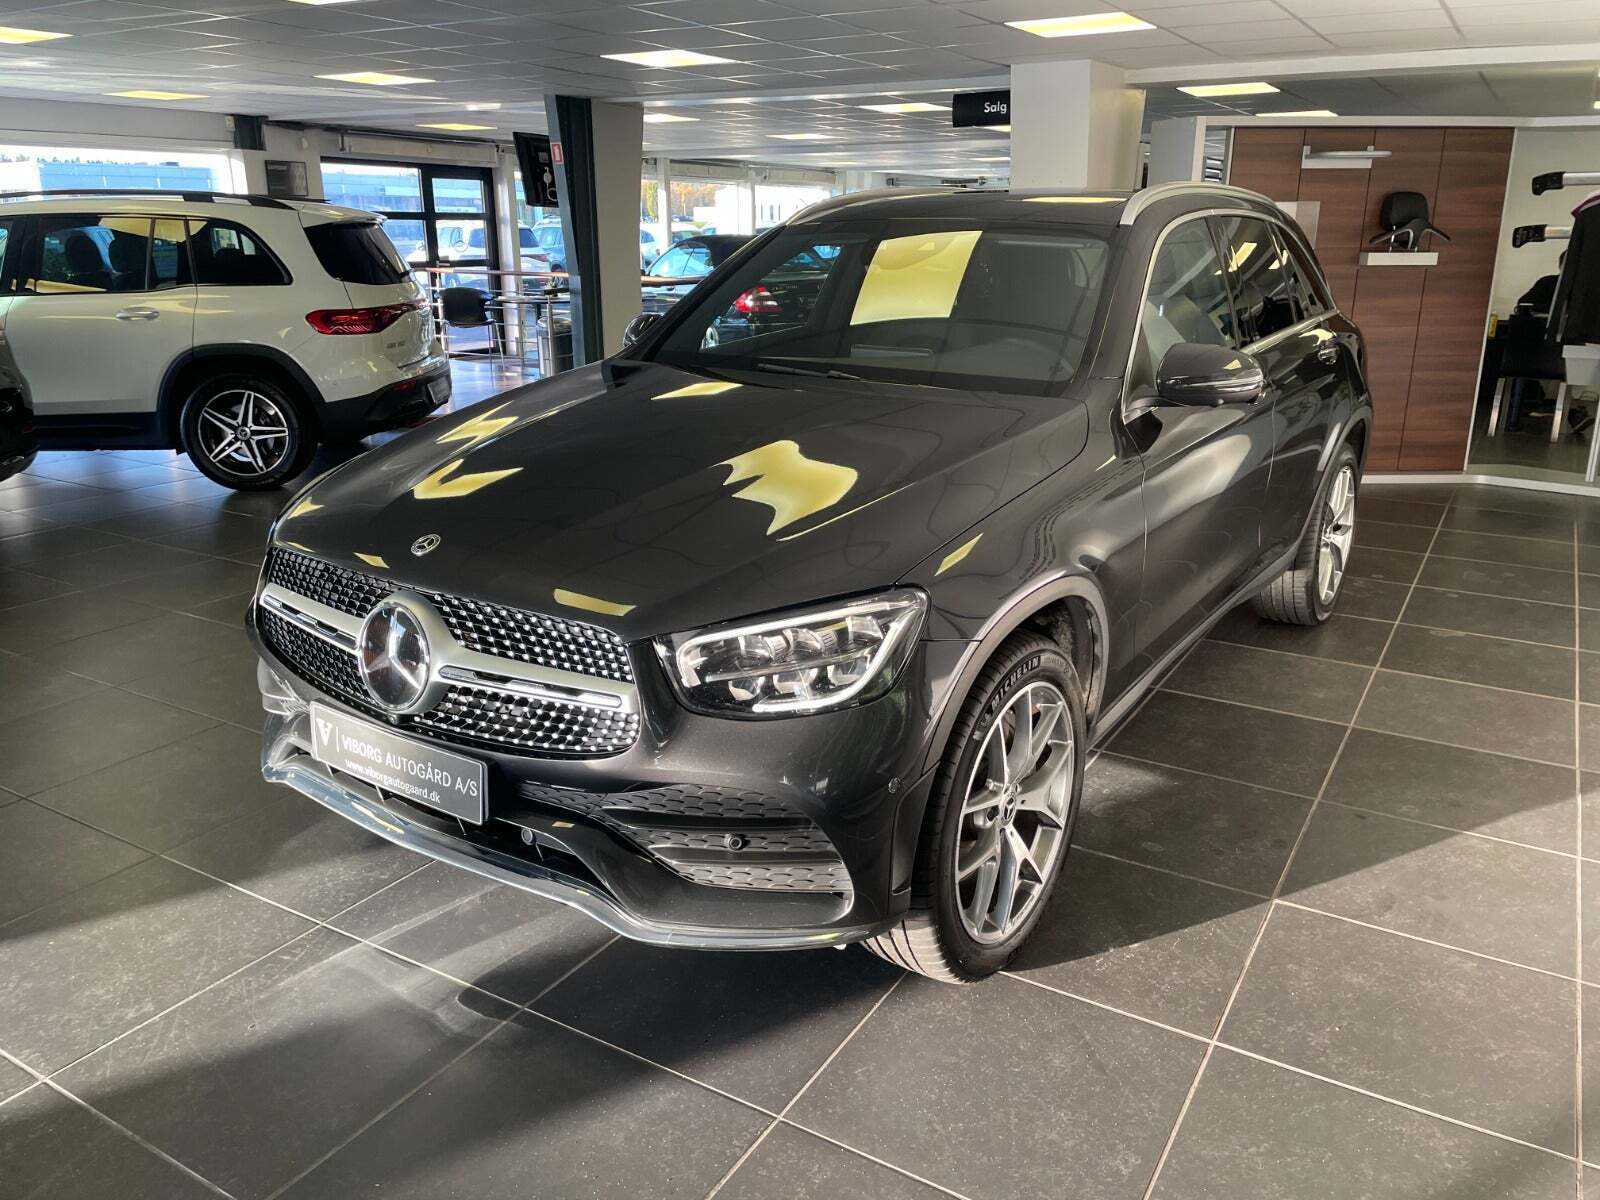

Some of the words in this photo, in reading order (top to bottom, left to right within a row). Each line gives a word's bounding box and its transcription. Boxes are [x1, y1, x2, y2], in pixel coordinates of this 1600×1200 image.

[984, 101, 1007, 114] Salg
[991, 656, 1040, 712] MICHELIN
[342, 734, 382, 764] VIBORG
[385, 752, 451, 787] AUTOGÅRD
[455, 776, 478, 797] A/S
[345, 759, 441, 804] www.viborgautogaard.dk
